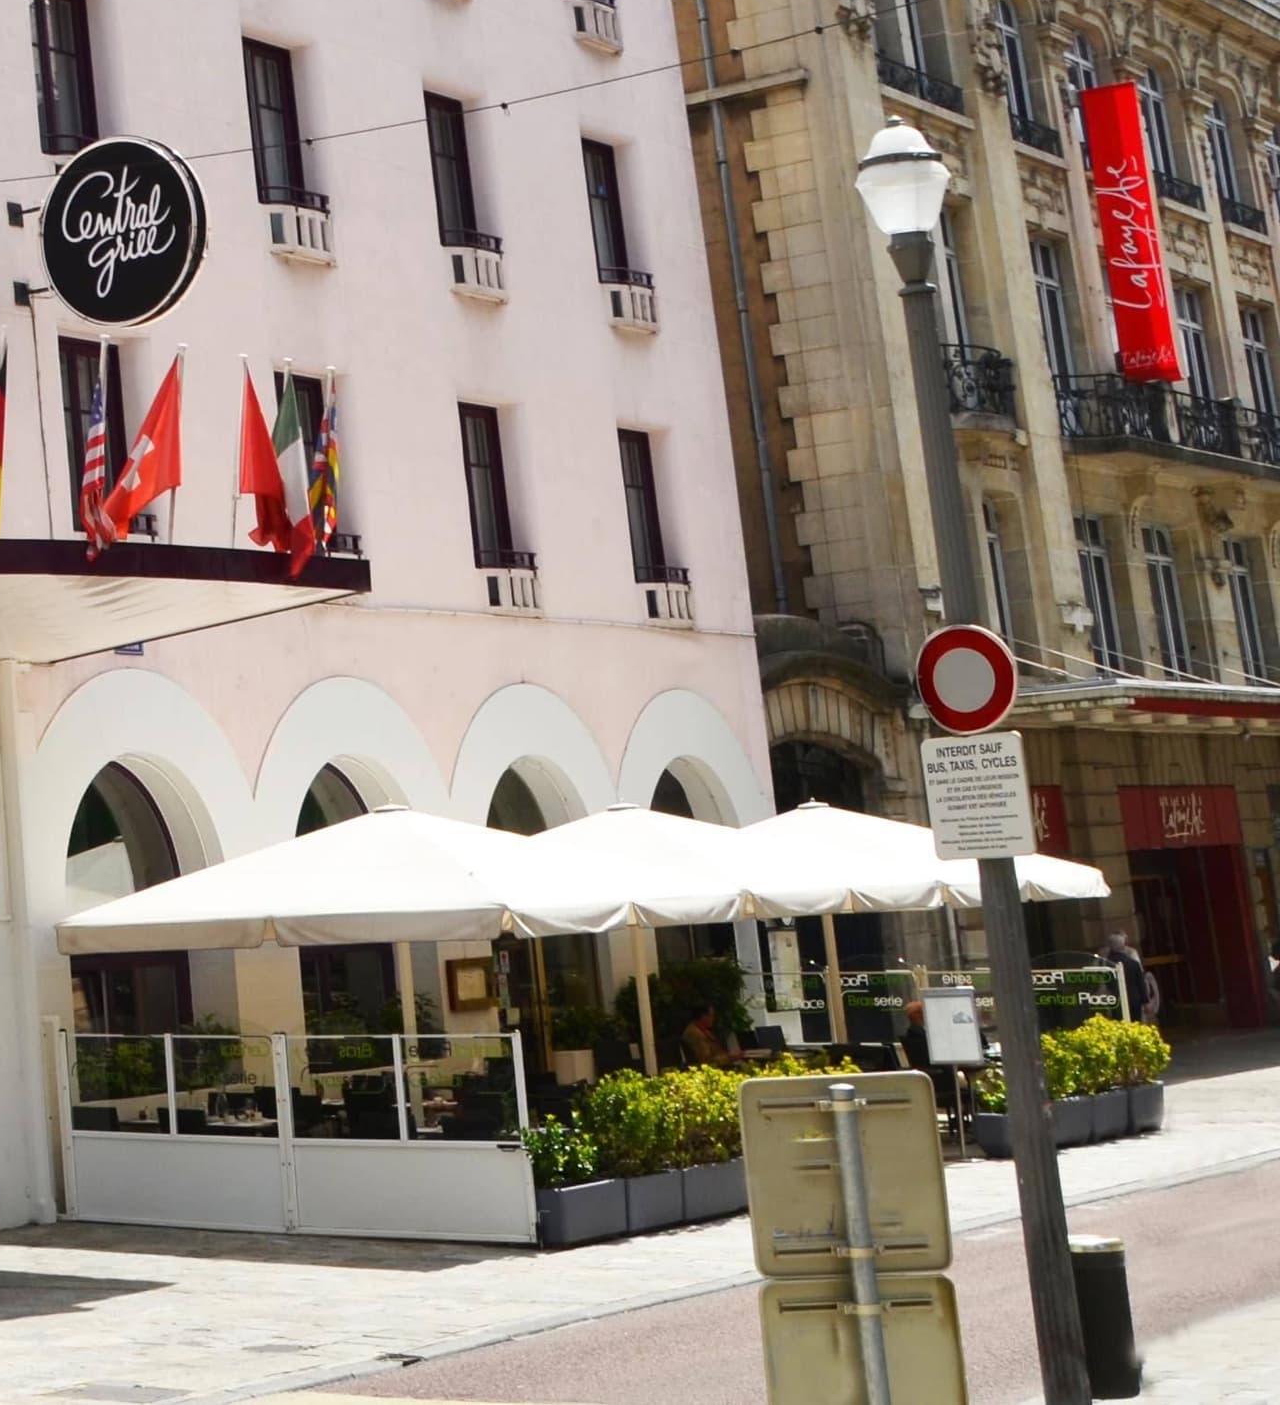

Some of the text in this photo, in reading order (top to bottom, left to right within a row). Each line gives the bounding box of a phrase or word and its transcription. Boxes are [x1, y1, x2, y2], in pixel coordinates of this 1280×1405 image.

[62, 165, 171, 243] Central
[936, 742, 1003, 758] INTERDIT SAUF
[981, 755, 1017, 769] CYCLES
[1078, 992, 1117, 1005] Place
